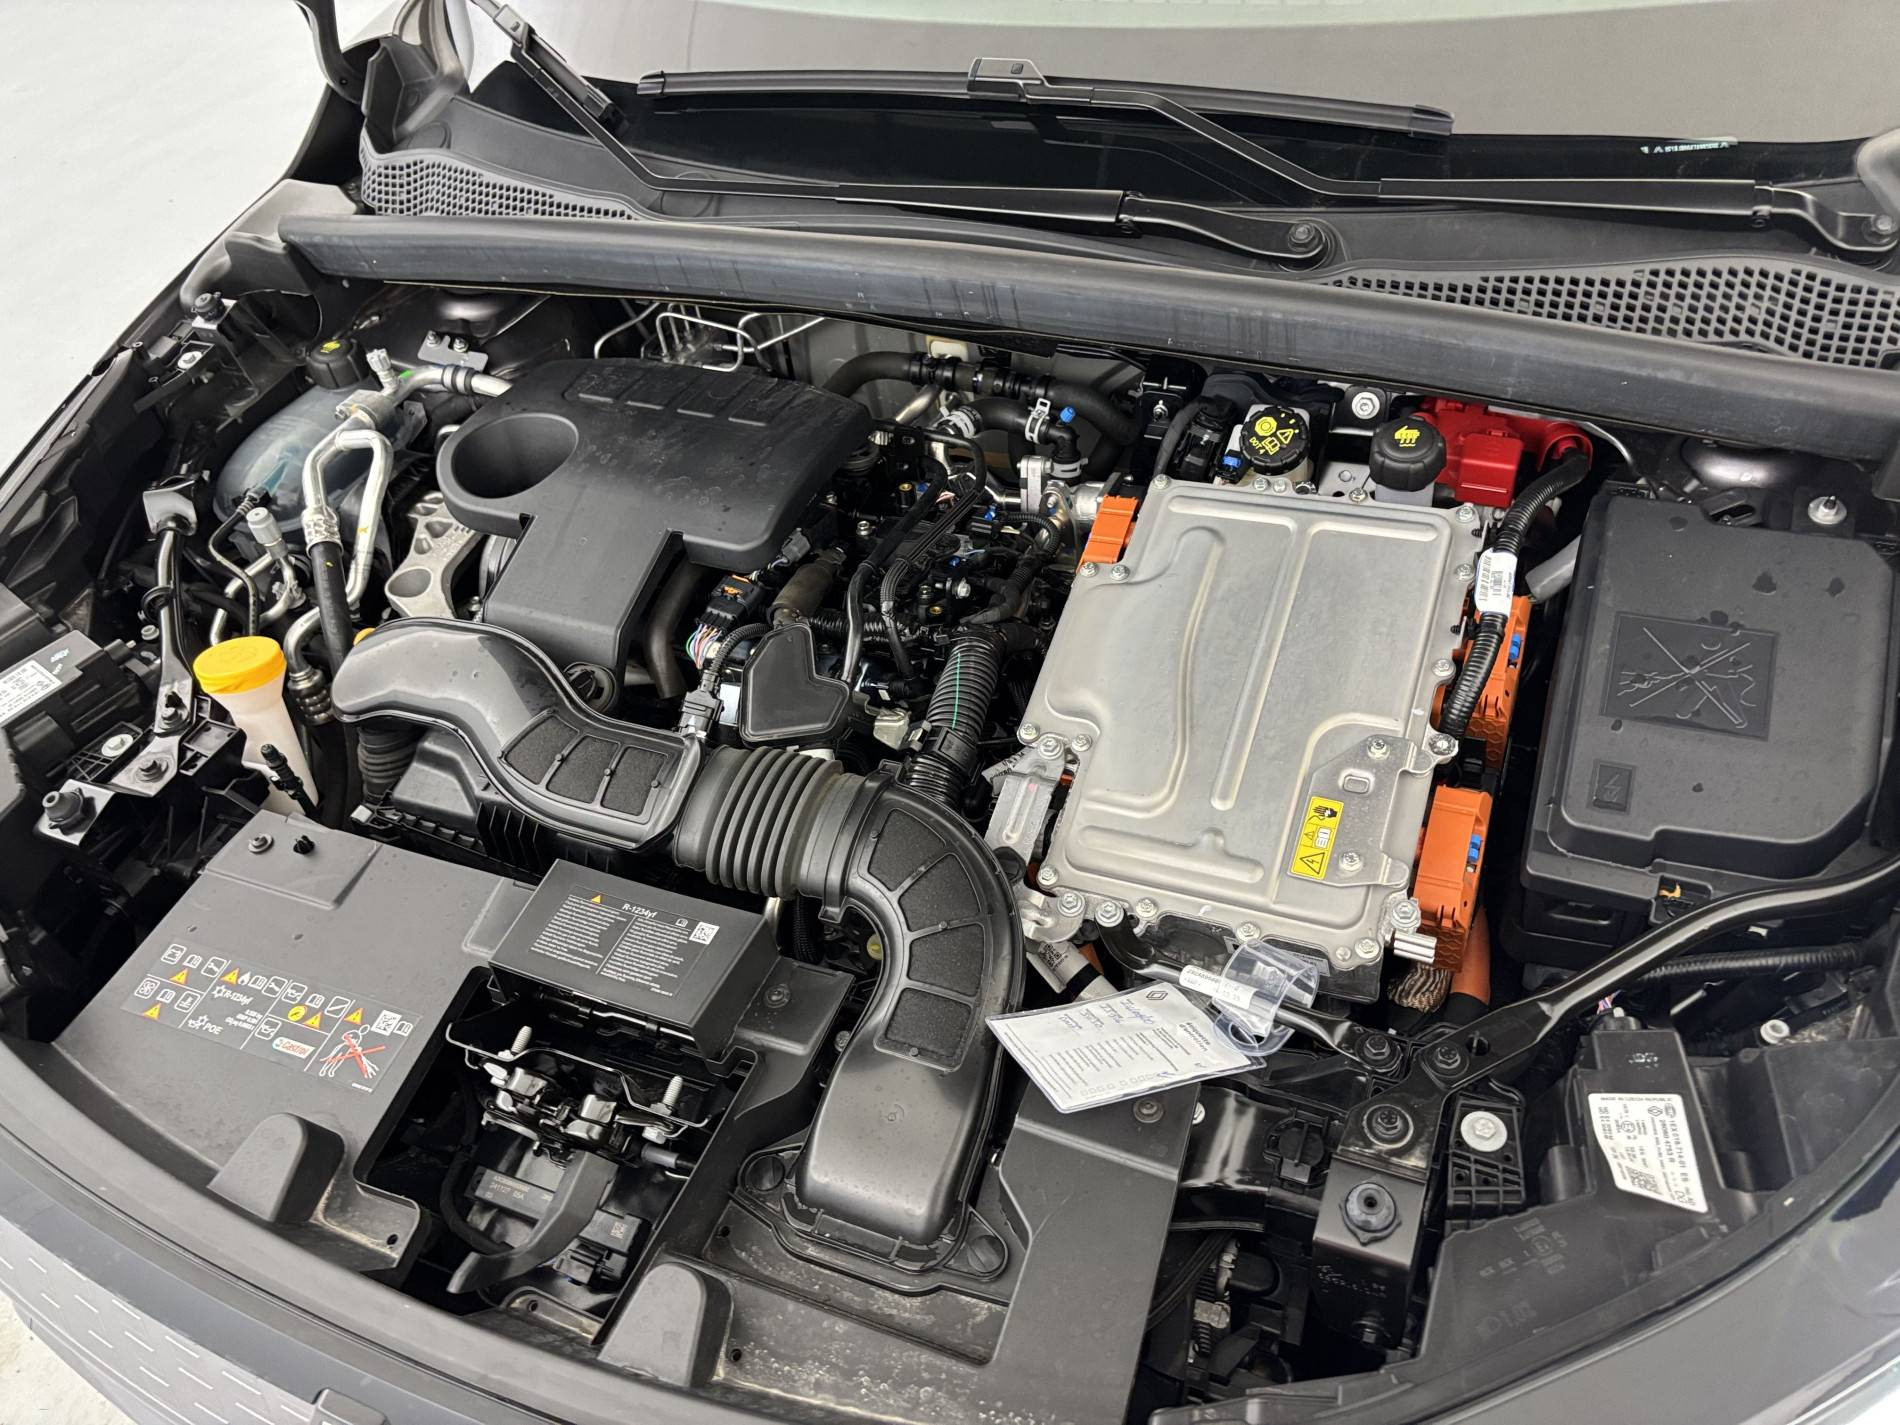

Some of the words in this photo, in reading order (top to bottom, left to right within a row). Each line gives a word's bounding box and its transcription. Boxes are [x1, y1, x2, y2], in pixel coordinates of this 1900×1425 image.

[1249, 436, 1263, 450] DOT
[621, 902, 658, 919] R-1234yf
[204, 1022, 223, 1035] POE
[280, 1040, 311, 1056] Castrol
